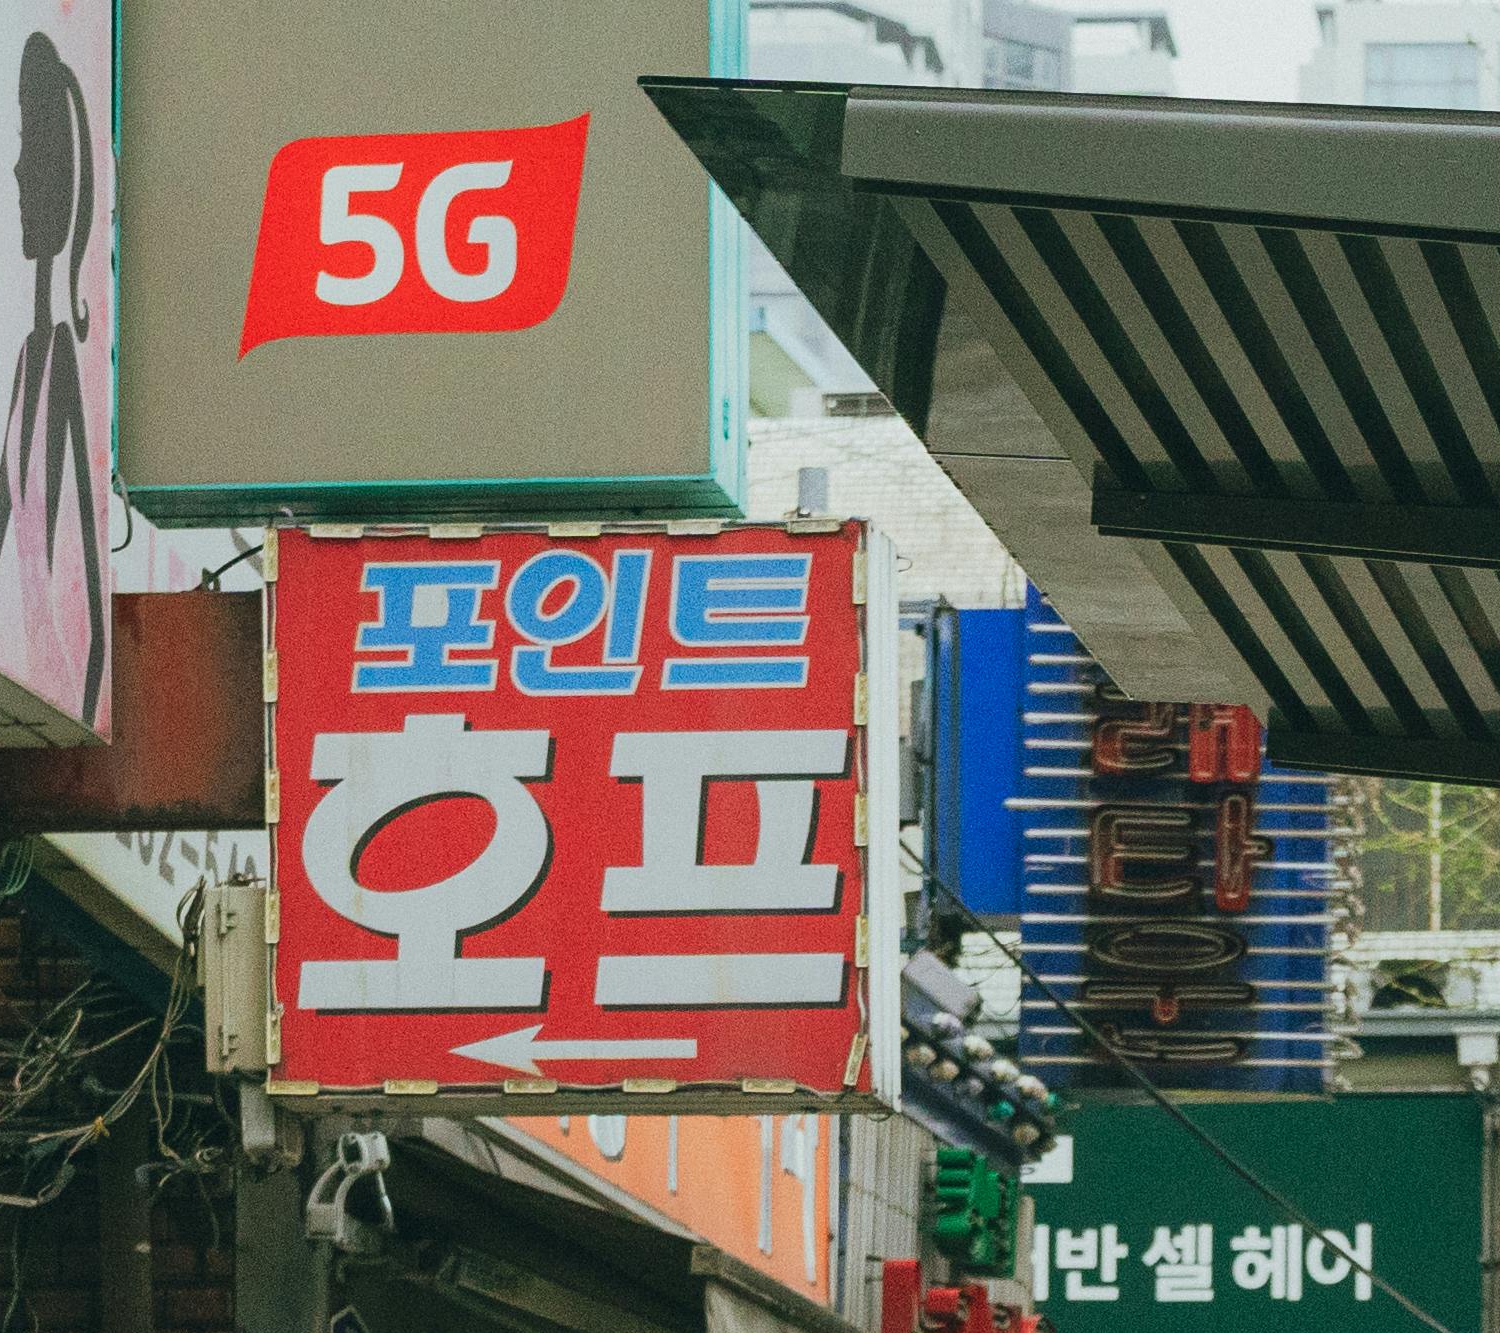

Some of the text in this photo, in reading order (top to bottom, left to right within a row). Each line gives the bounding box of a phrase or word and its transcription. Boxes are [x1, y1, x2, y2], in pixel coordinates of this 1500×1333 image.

[314, 159, 518, 307] 5G
[352, 548, 813, 696] 포인트
[298, 713, 854, 1015] 호프
[1142, 1224, 1215, 1301] 셀
[1231, 1224, 1374, 1301] 헤어
